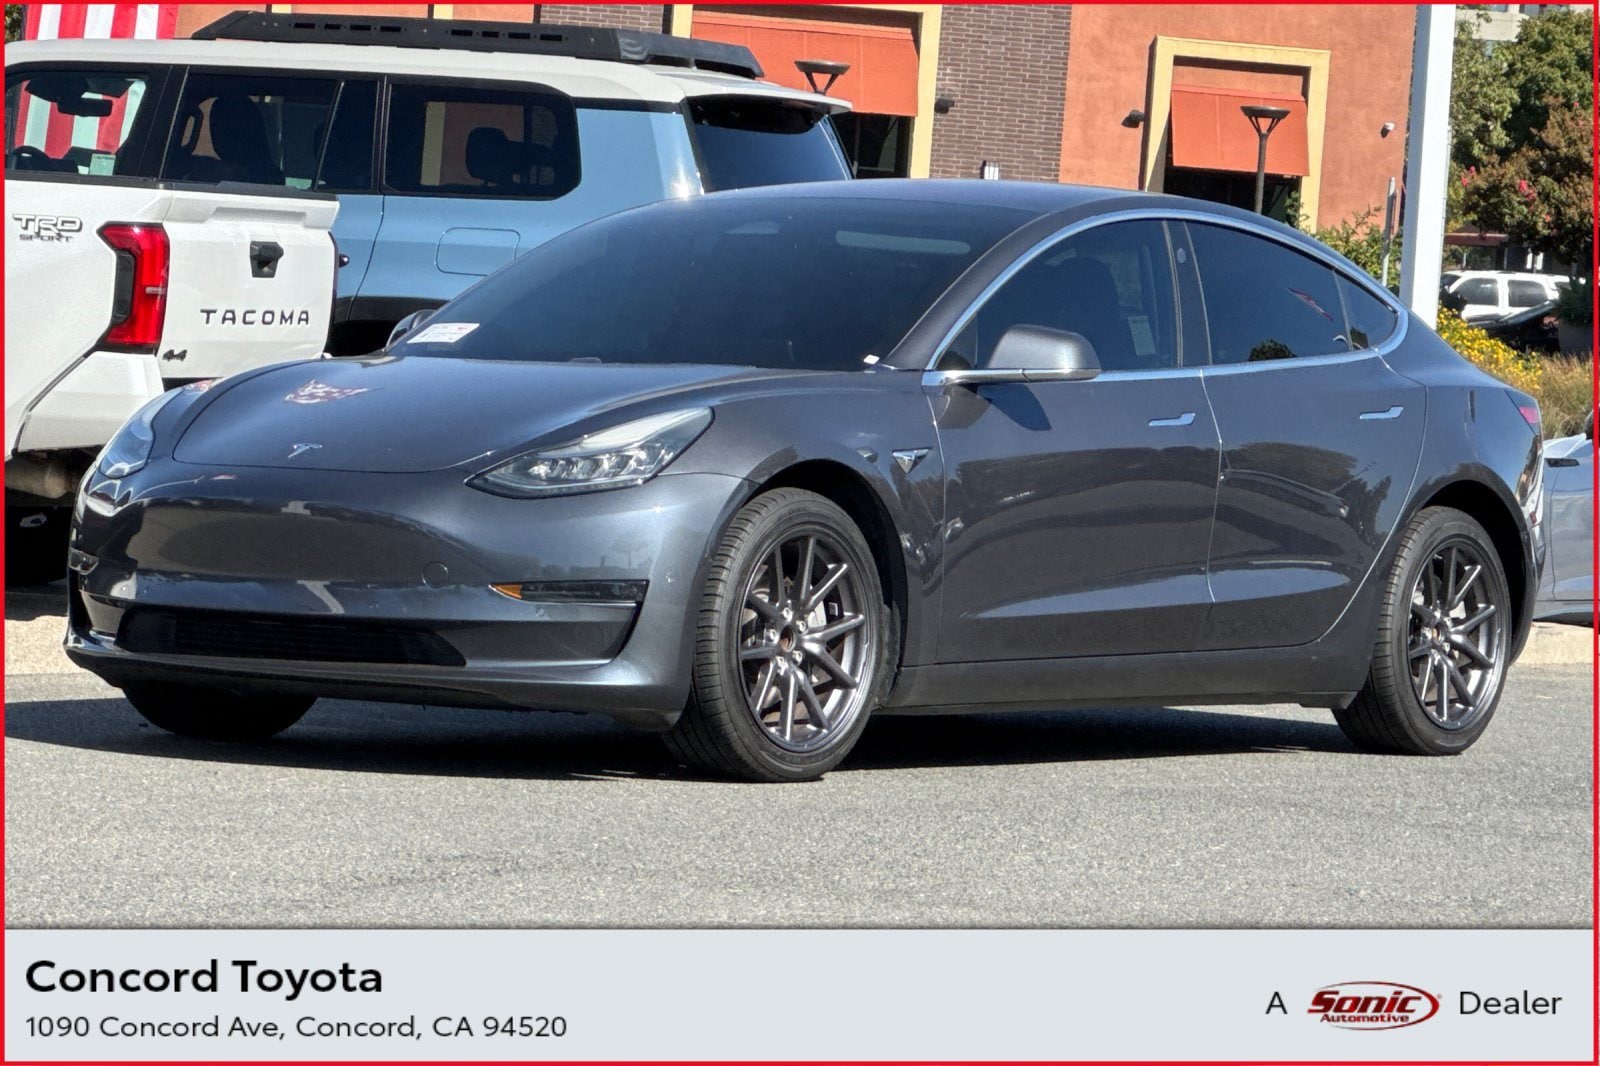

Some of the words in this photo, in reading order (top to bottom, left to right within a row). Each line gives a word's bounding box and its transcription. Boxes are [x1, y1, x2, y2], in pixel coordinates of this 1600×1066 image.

[12, 214, 83, 235] TRD
[19, 233, 73, 242] SPORT
[200, 308, 310, 326] TACOMA
